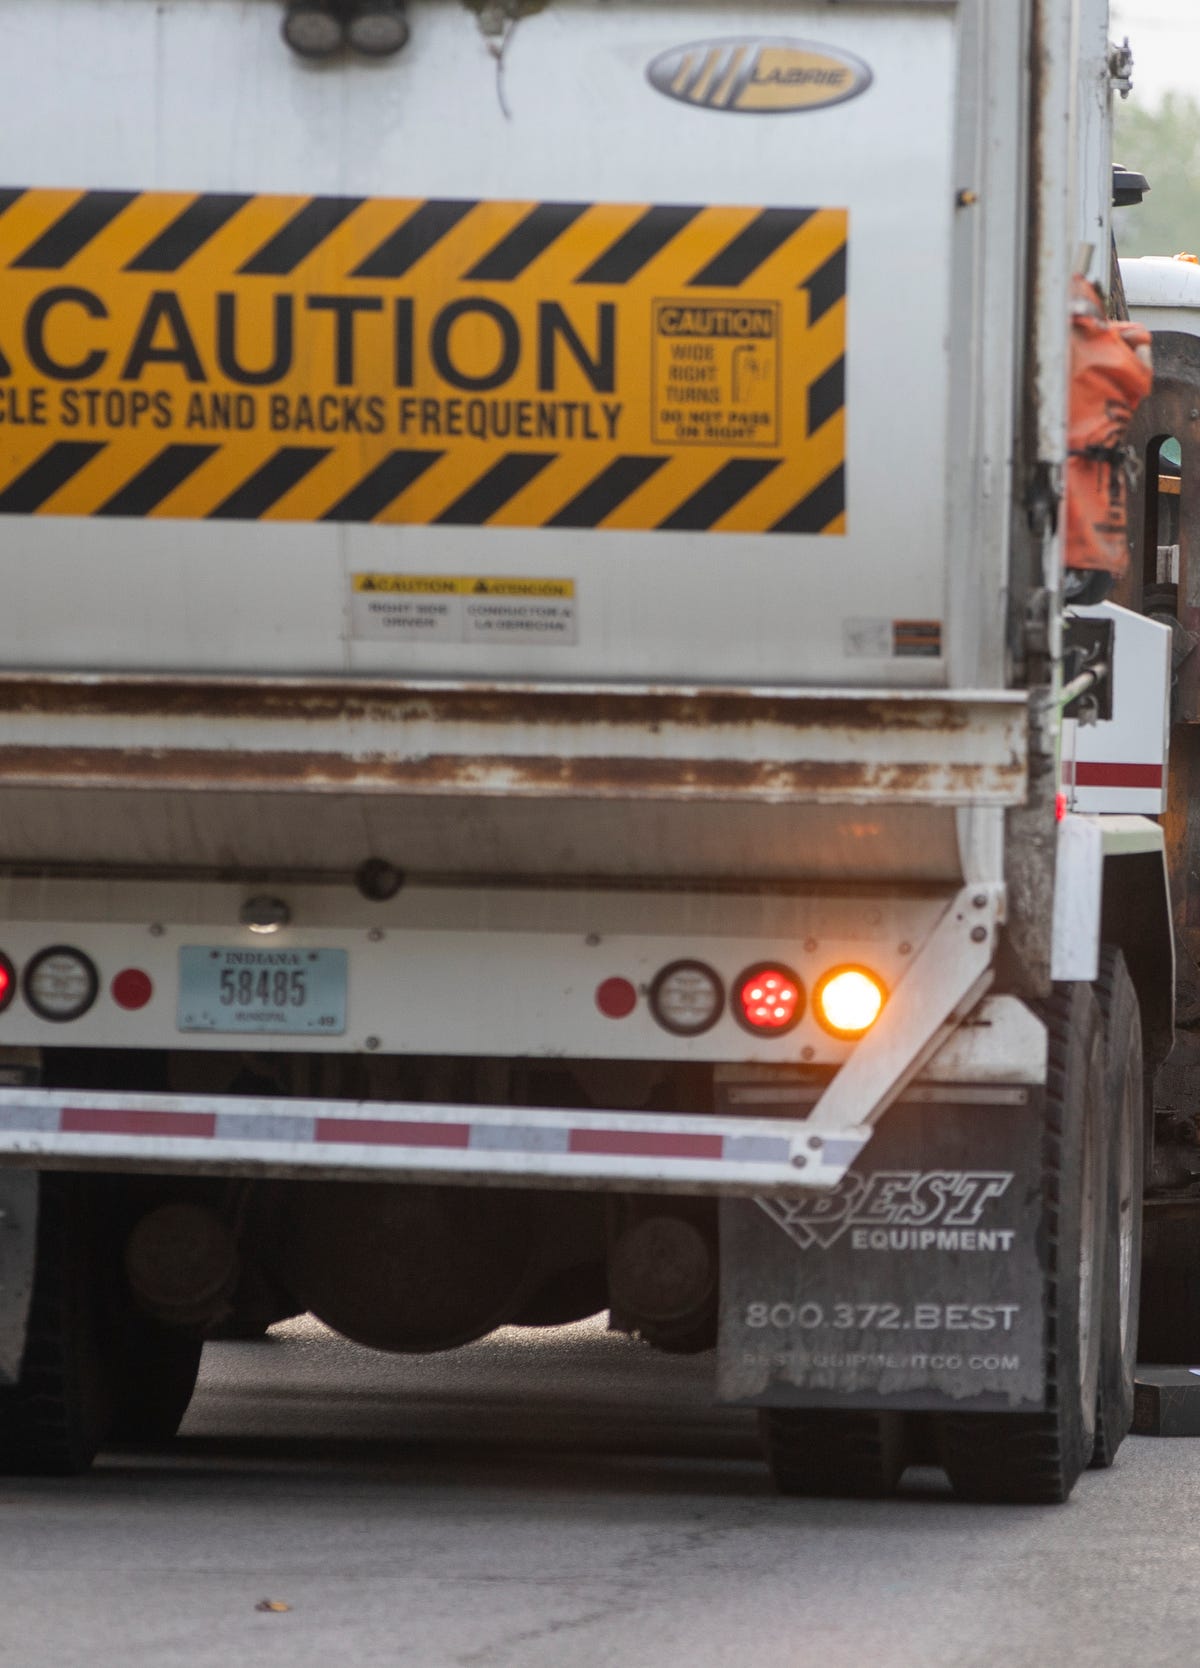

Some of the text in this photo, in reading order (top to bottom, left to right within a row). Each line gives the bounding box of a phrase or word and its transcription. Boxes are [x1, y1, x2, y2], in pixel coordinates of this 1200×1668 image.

[750, 67, 848, 86] LABRIE
[661, 310, 771, 336] CAUTION
[23, 285, 616, 393] CAUTION
[671, 343, 715, 361] WIDE
[668, 364, 718, 382] RIGHT
[666, 385, 721, 404] TURNS
[0, 386, 622, 441] LE STOPS AND BACKS FREQUENTLY
[660, 409, 770, 427] DO NOT PASS
[676, 424, 757, 439] ON RIGHT
[376, 576, 457, 594] CAUTION
[368, 602, 449, 617] RIGHT SIDE
[382, 616, 437, 629] DRIVER
[225, 952, 300, 966] INDIANA
[219, 968, 307, 1007] 58485
[790, 1170, 1015, 1227] BEST
[851, 1229, 1016, 1252] EQUIPMENT
[745, 1303, 1020, 1332] 800.372.BEST
